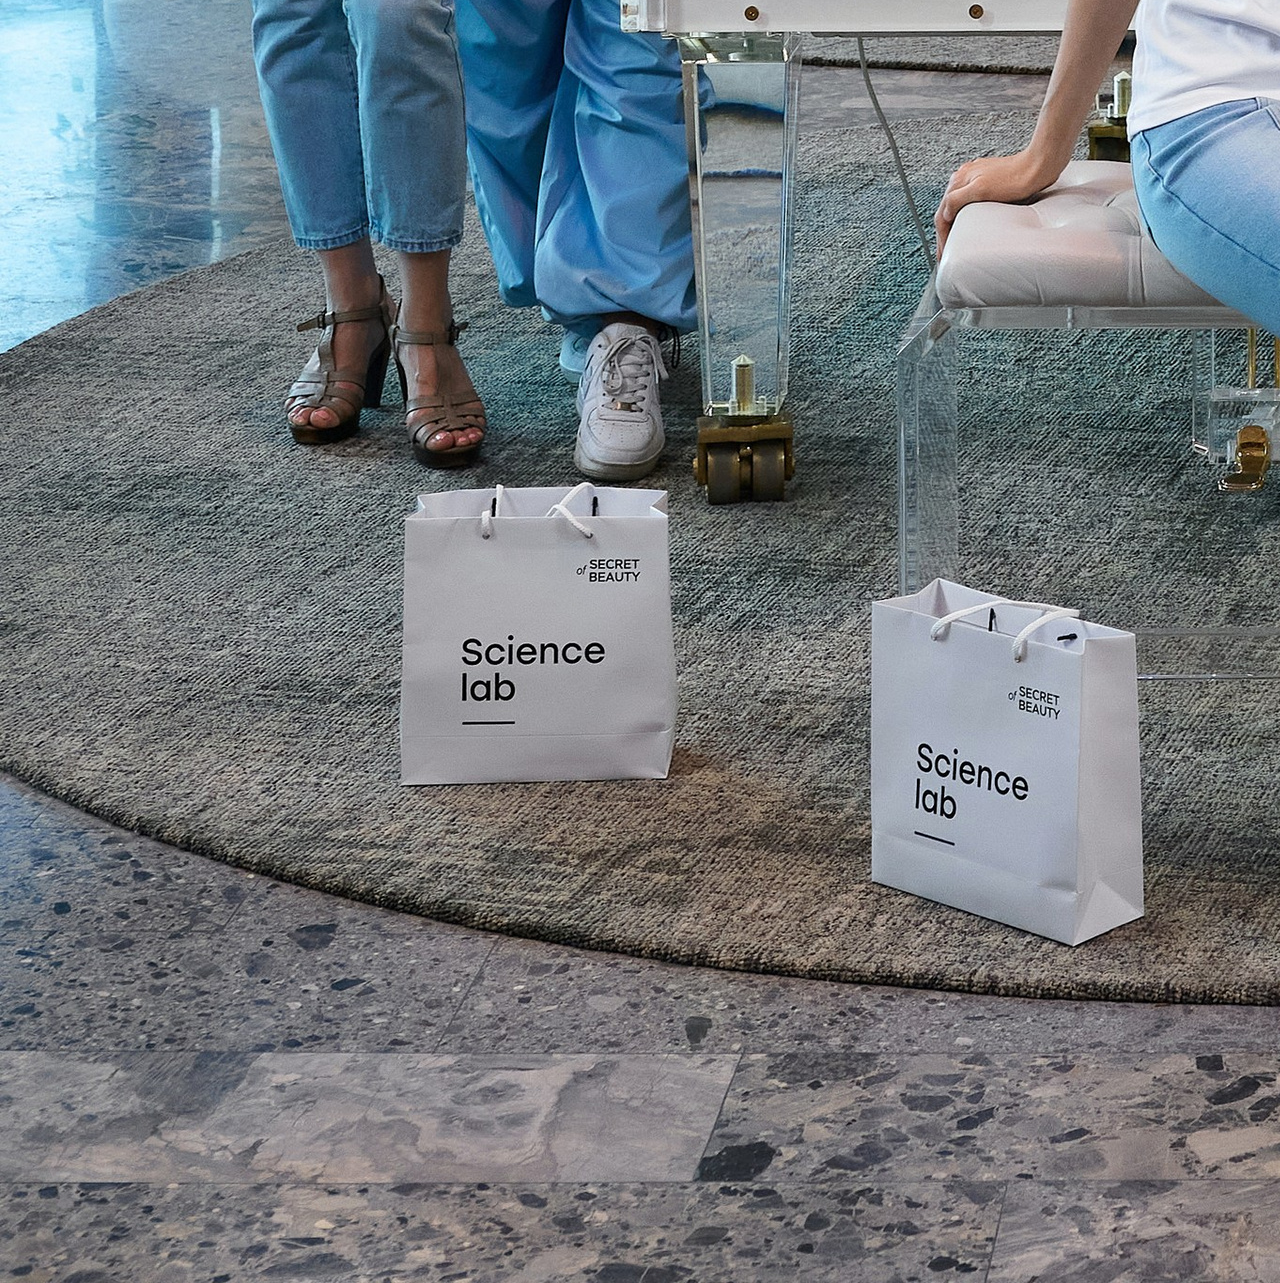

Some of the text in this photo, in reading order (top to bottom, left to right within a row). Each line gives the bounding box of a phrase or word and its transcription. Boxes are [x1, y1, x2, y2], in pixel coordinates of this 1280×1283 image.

[575, 558, 641, 576] of SECRET
[588, 571, 641, 583] BEAUTY
[461, 634, 606, 666] Science
[461, 672, 516, 702] lab
[1007, 685, 1061, 706] of SECRET
[1018, 698, 1062, 721] BEAUTY
[916, 743, 1029, 801] Science
[915, 777, 957, 820] lab
